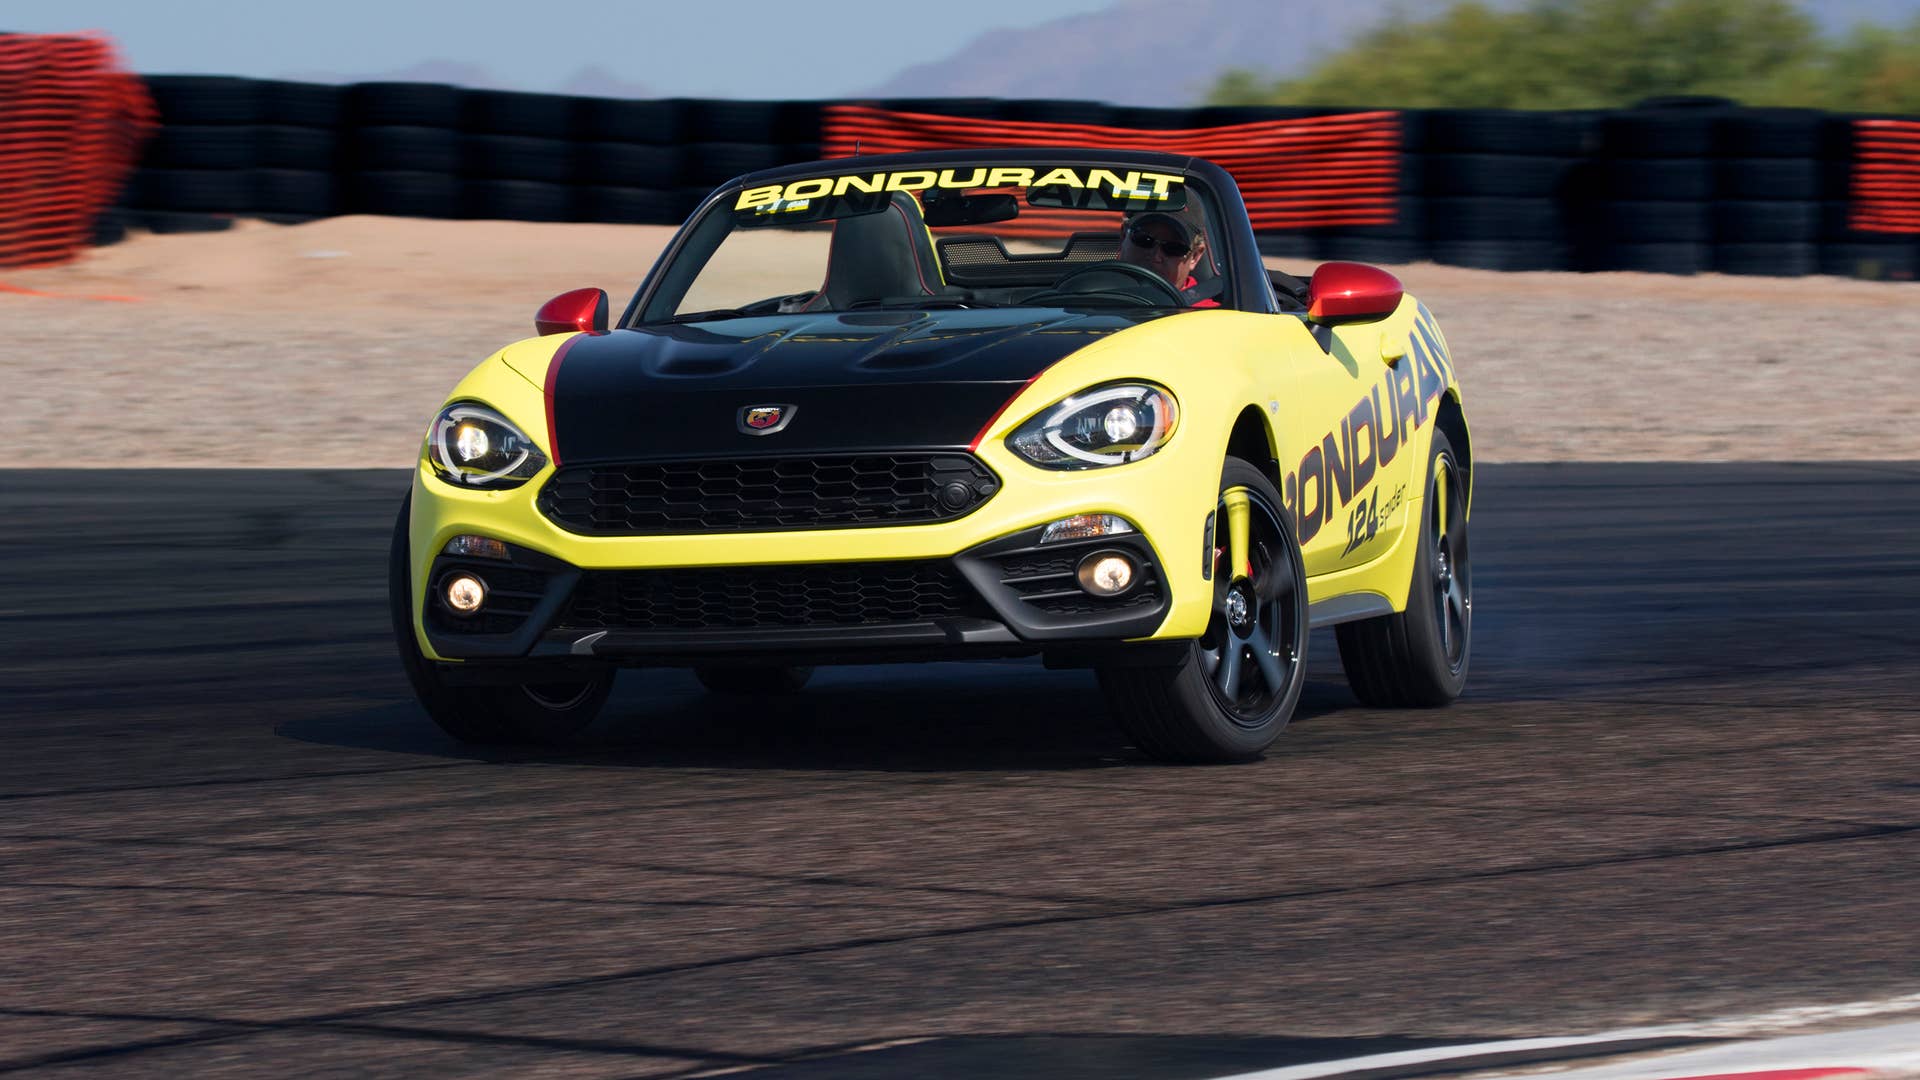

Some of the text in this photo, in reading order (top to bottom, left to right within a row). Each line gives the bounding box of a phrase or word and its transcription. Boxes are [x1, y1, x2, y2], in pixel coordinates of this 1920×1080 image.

[735, 167, 1185, 211] BONDURANT
[1284, 300, 1457, 546] BONDURAN
[1339, 484, 1379, 560] 124
